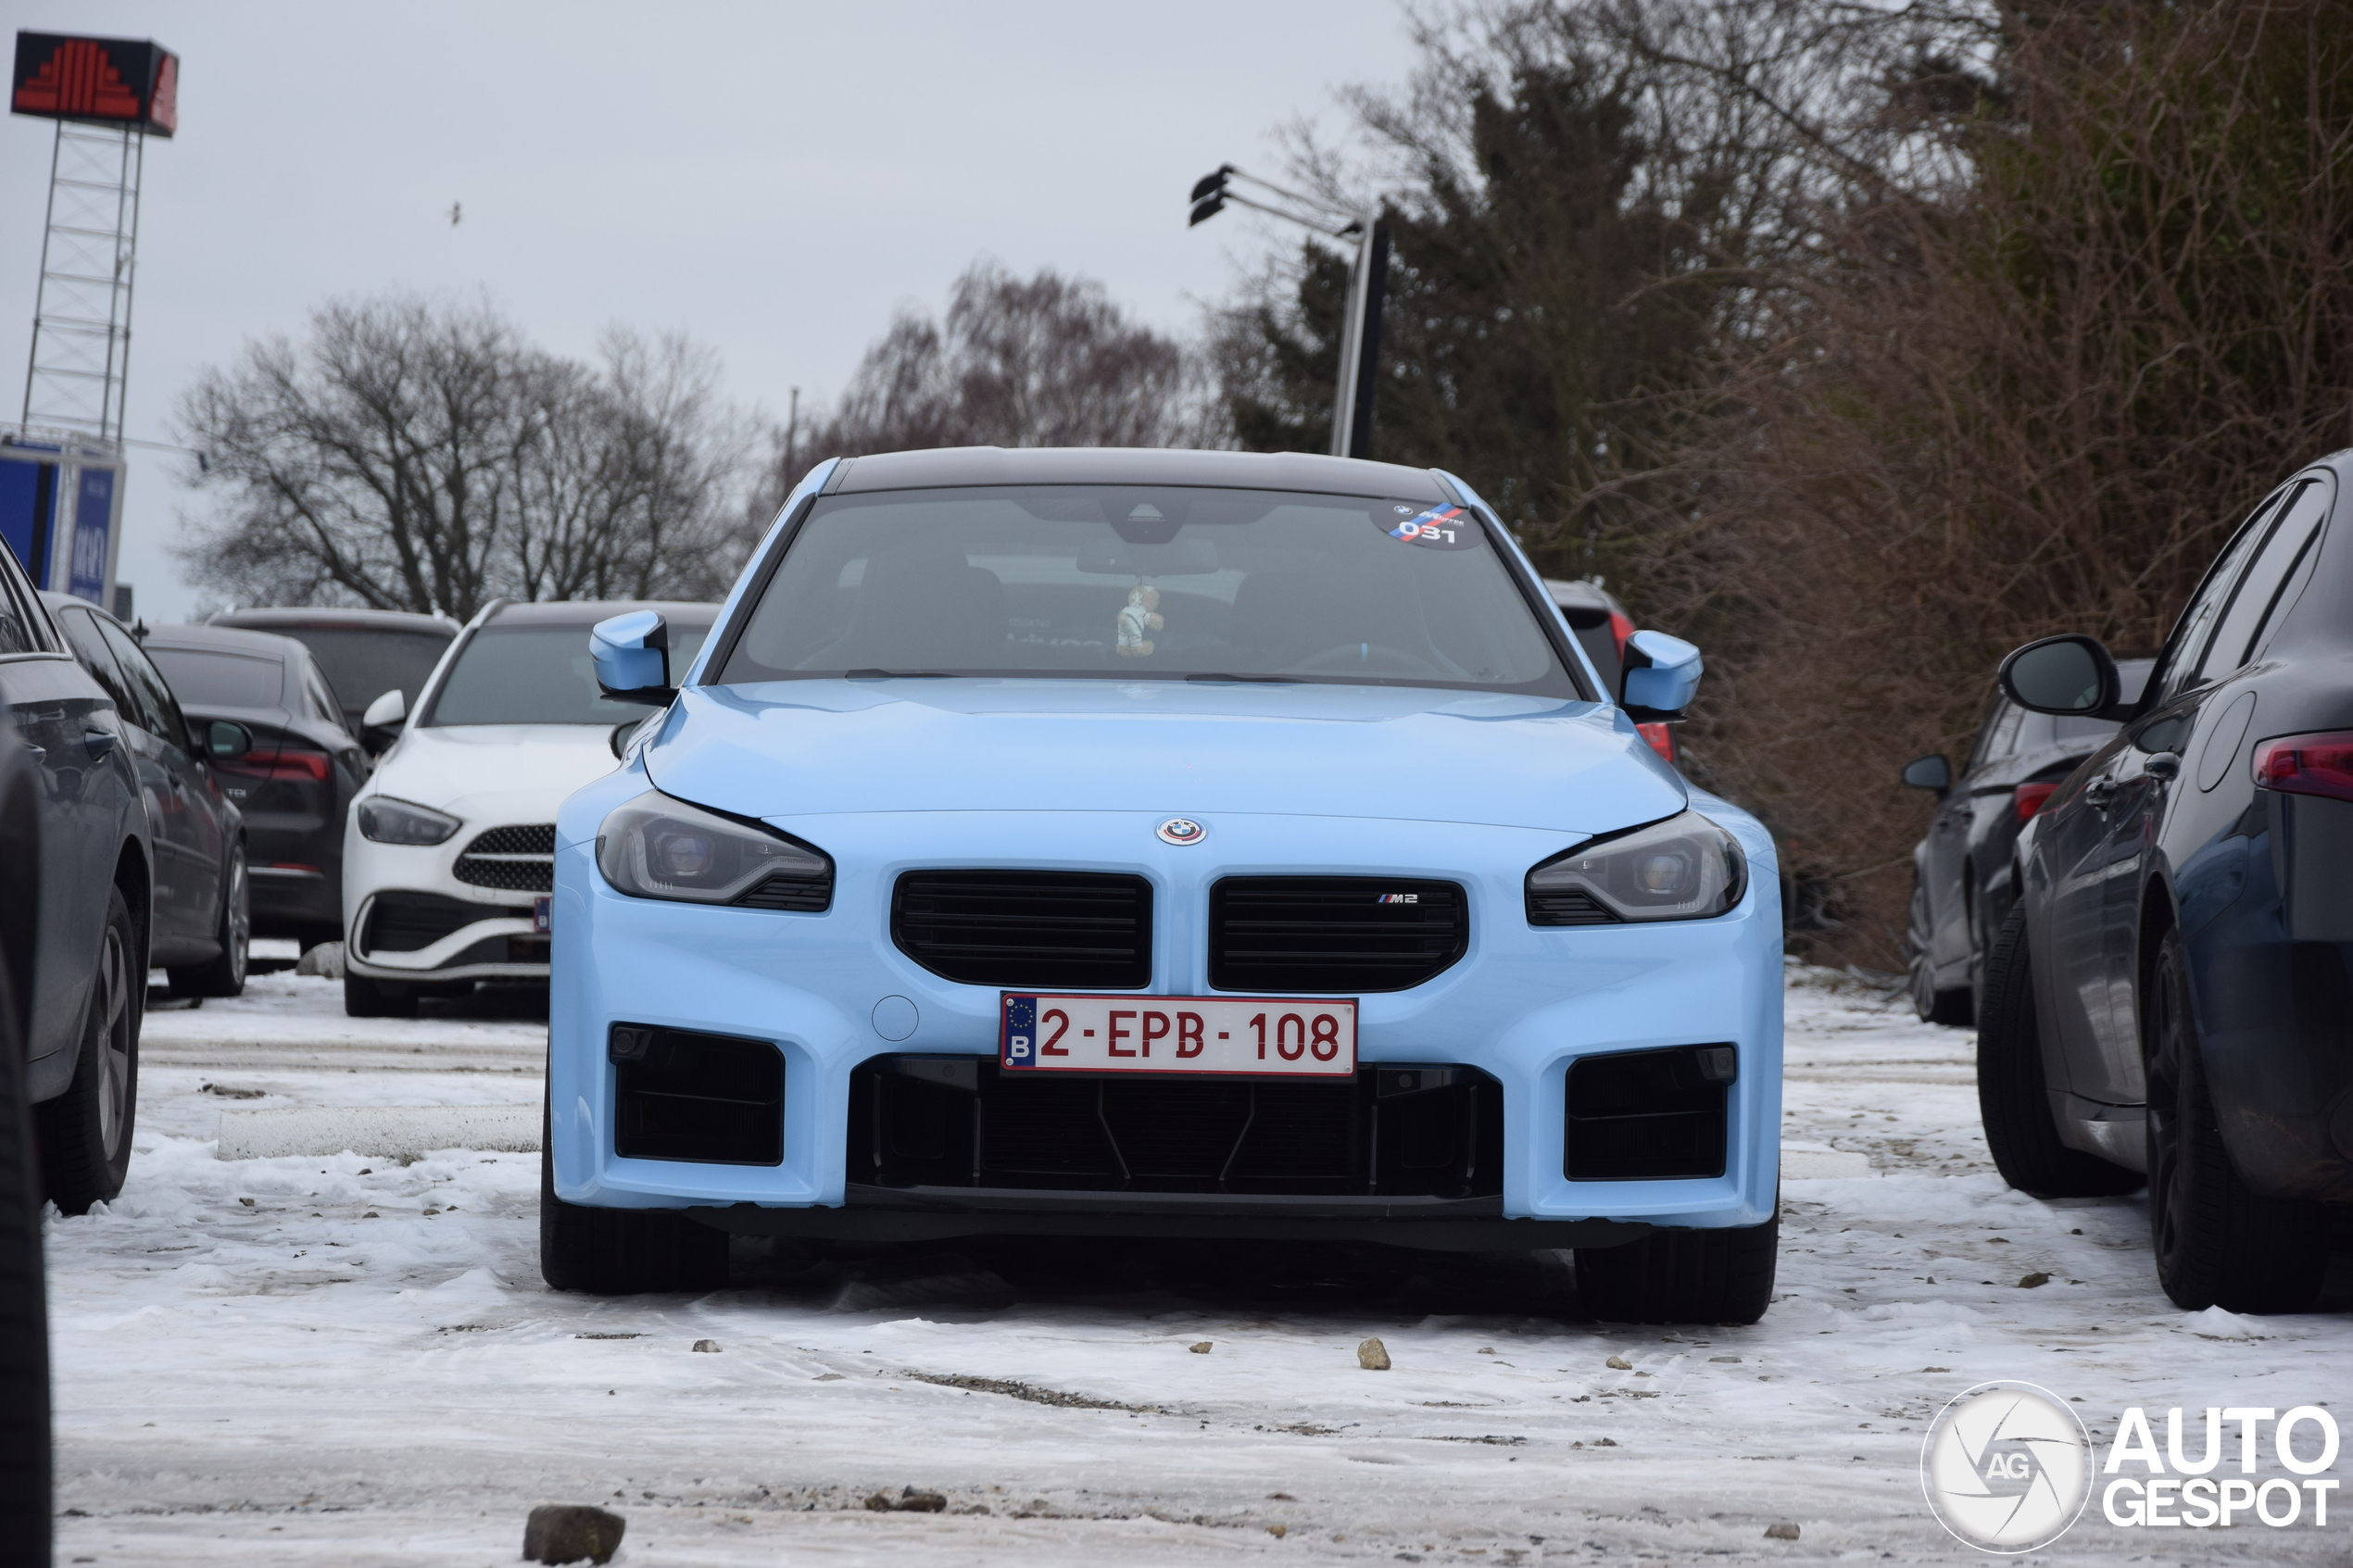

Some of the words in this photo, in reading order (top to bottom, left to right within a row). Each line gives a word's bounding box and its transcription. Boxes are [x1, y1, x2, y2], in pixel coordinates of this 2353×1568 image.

[1399, 521, 1455, 544] 031
[1040, 1008, 1340, 1061] 2-EPB-108
[1011, 1035, 1030, 1058] B
